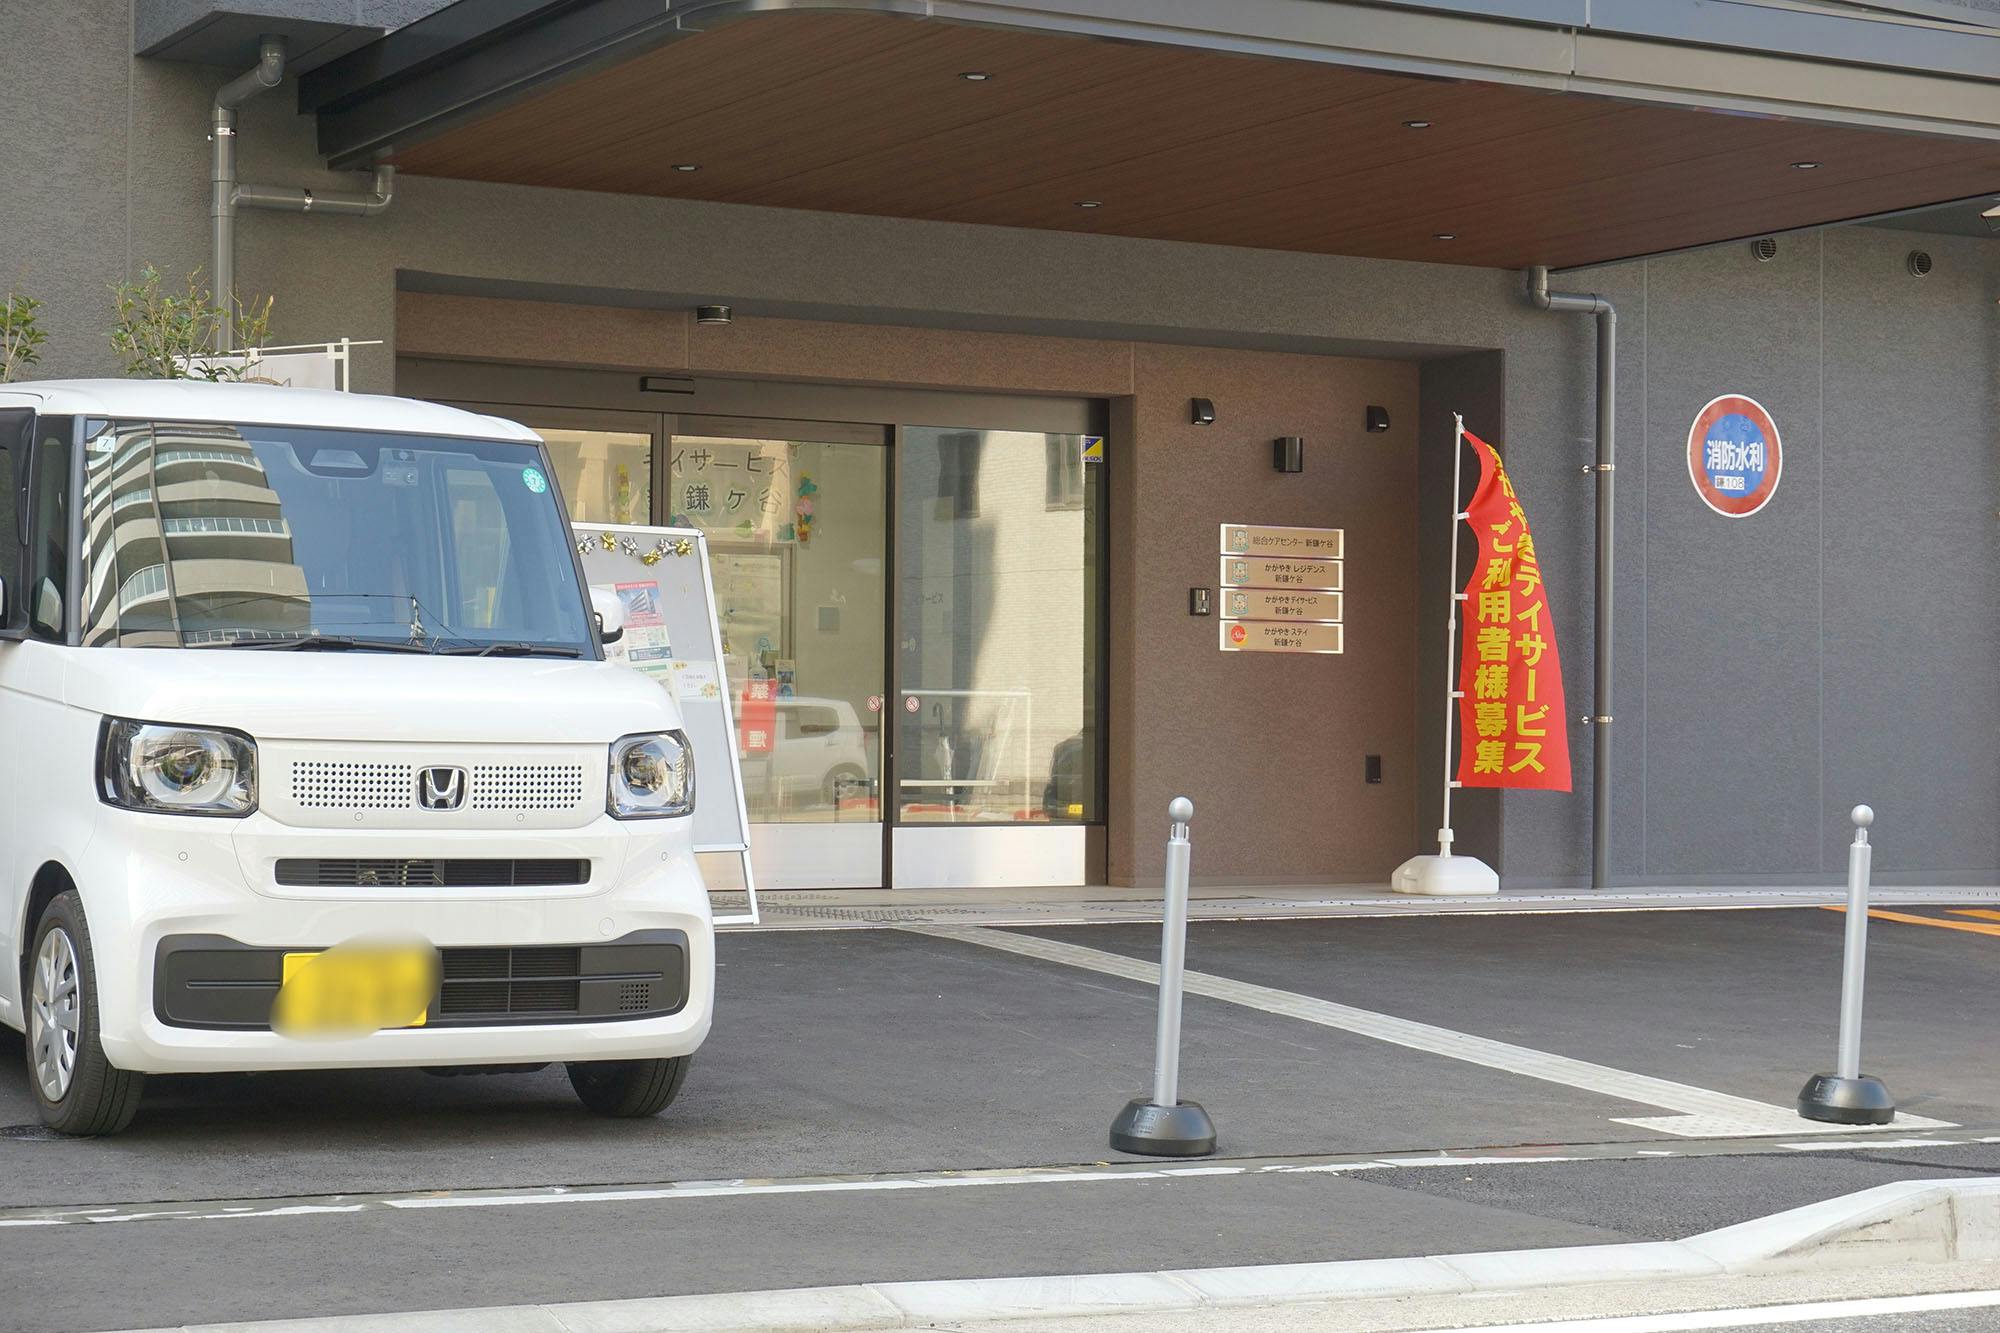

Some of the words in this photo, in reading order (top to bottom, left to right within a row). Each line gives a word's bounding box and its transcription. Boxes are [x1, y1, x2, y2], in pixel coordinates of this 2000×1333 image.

[1706, 439, 1764, 472] 消防水利
[647, 484, 782, 515] 鎌ケ谷
[1264, 564, 1291, 573] かがやき
[1293, 565, 1326, 574] レジデンス
[1265, 595, 1291, 604] かがやき
[1291, 596, 1318, 605] デイサービス
[1264, 627, 1289, 636] かがやき
[1291, 628, 1308, 637] ステイ
[1473, 520, 1513, 774] ご利用者様募集
